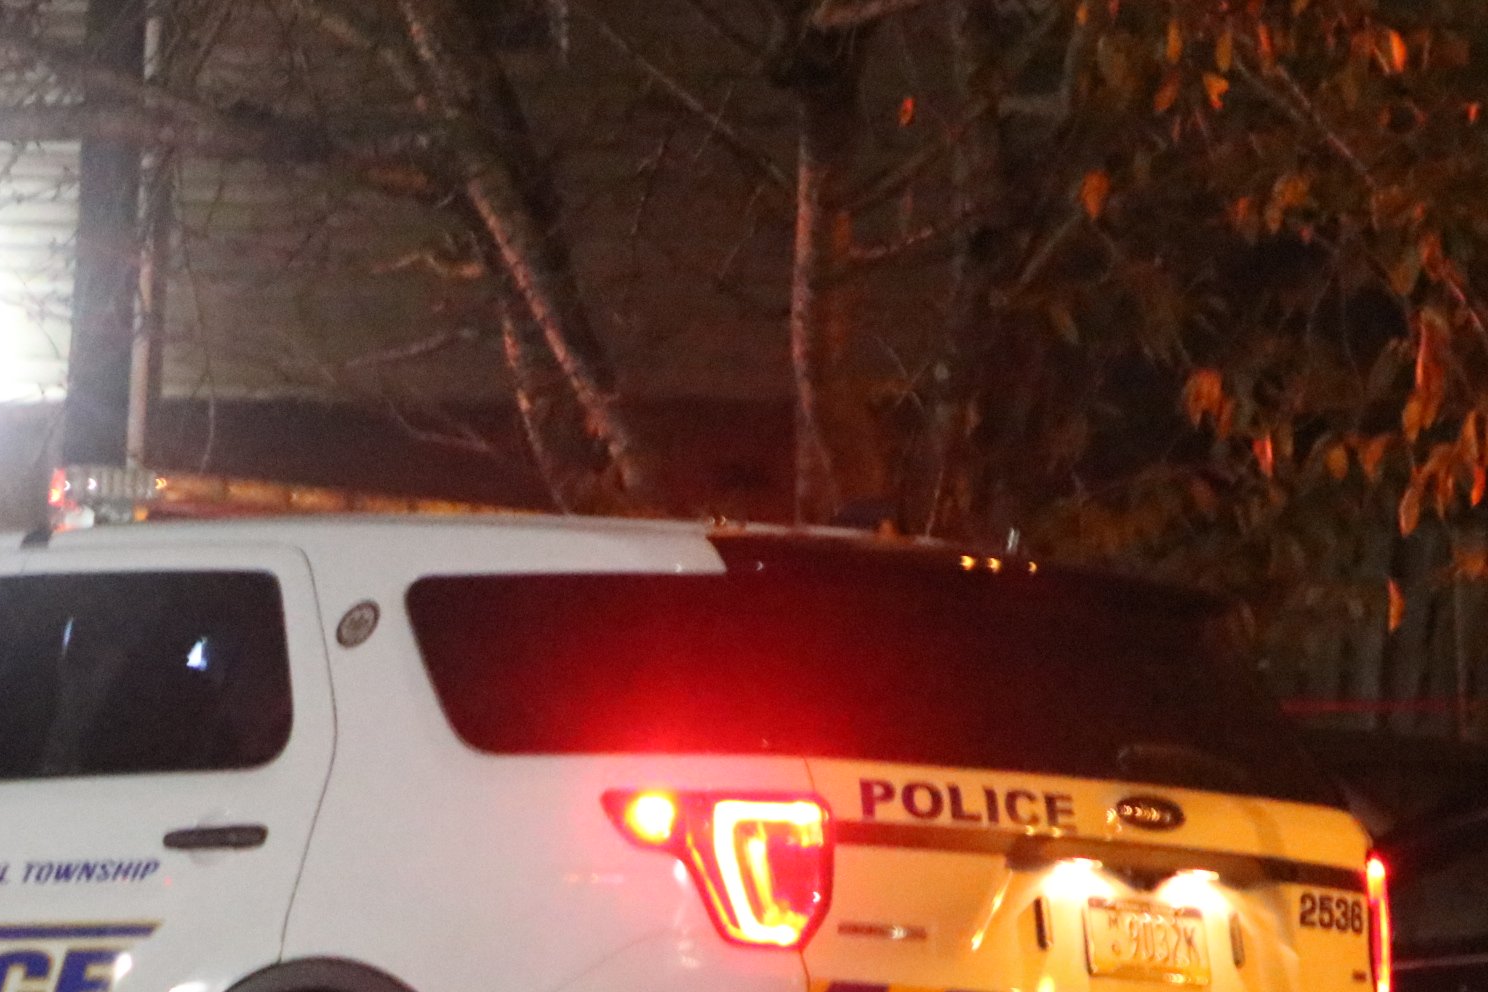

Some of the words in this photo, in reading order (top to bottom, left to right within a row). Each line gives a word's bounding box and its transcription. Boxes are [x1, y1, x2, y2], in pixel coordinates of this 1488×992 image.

[859, 778, 1079, 835] POLICE
[22, 856, 160, 884] TOWNSHIP
[1299, 892, 1363, 934] 2536
